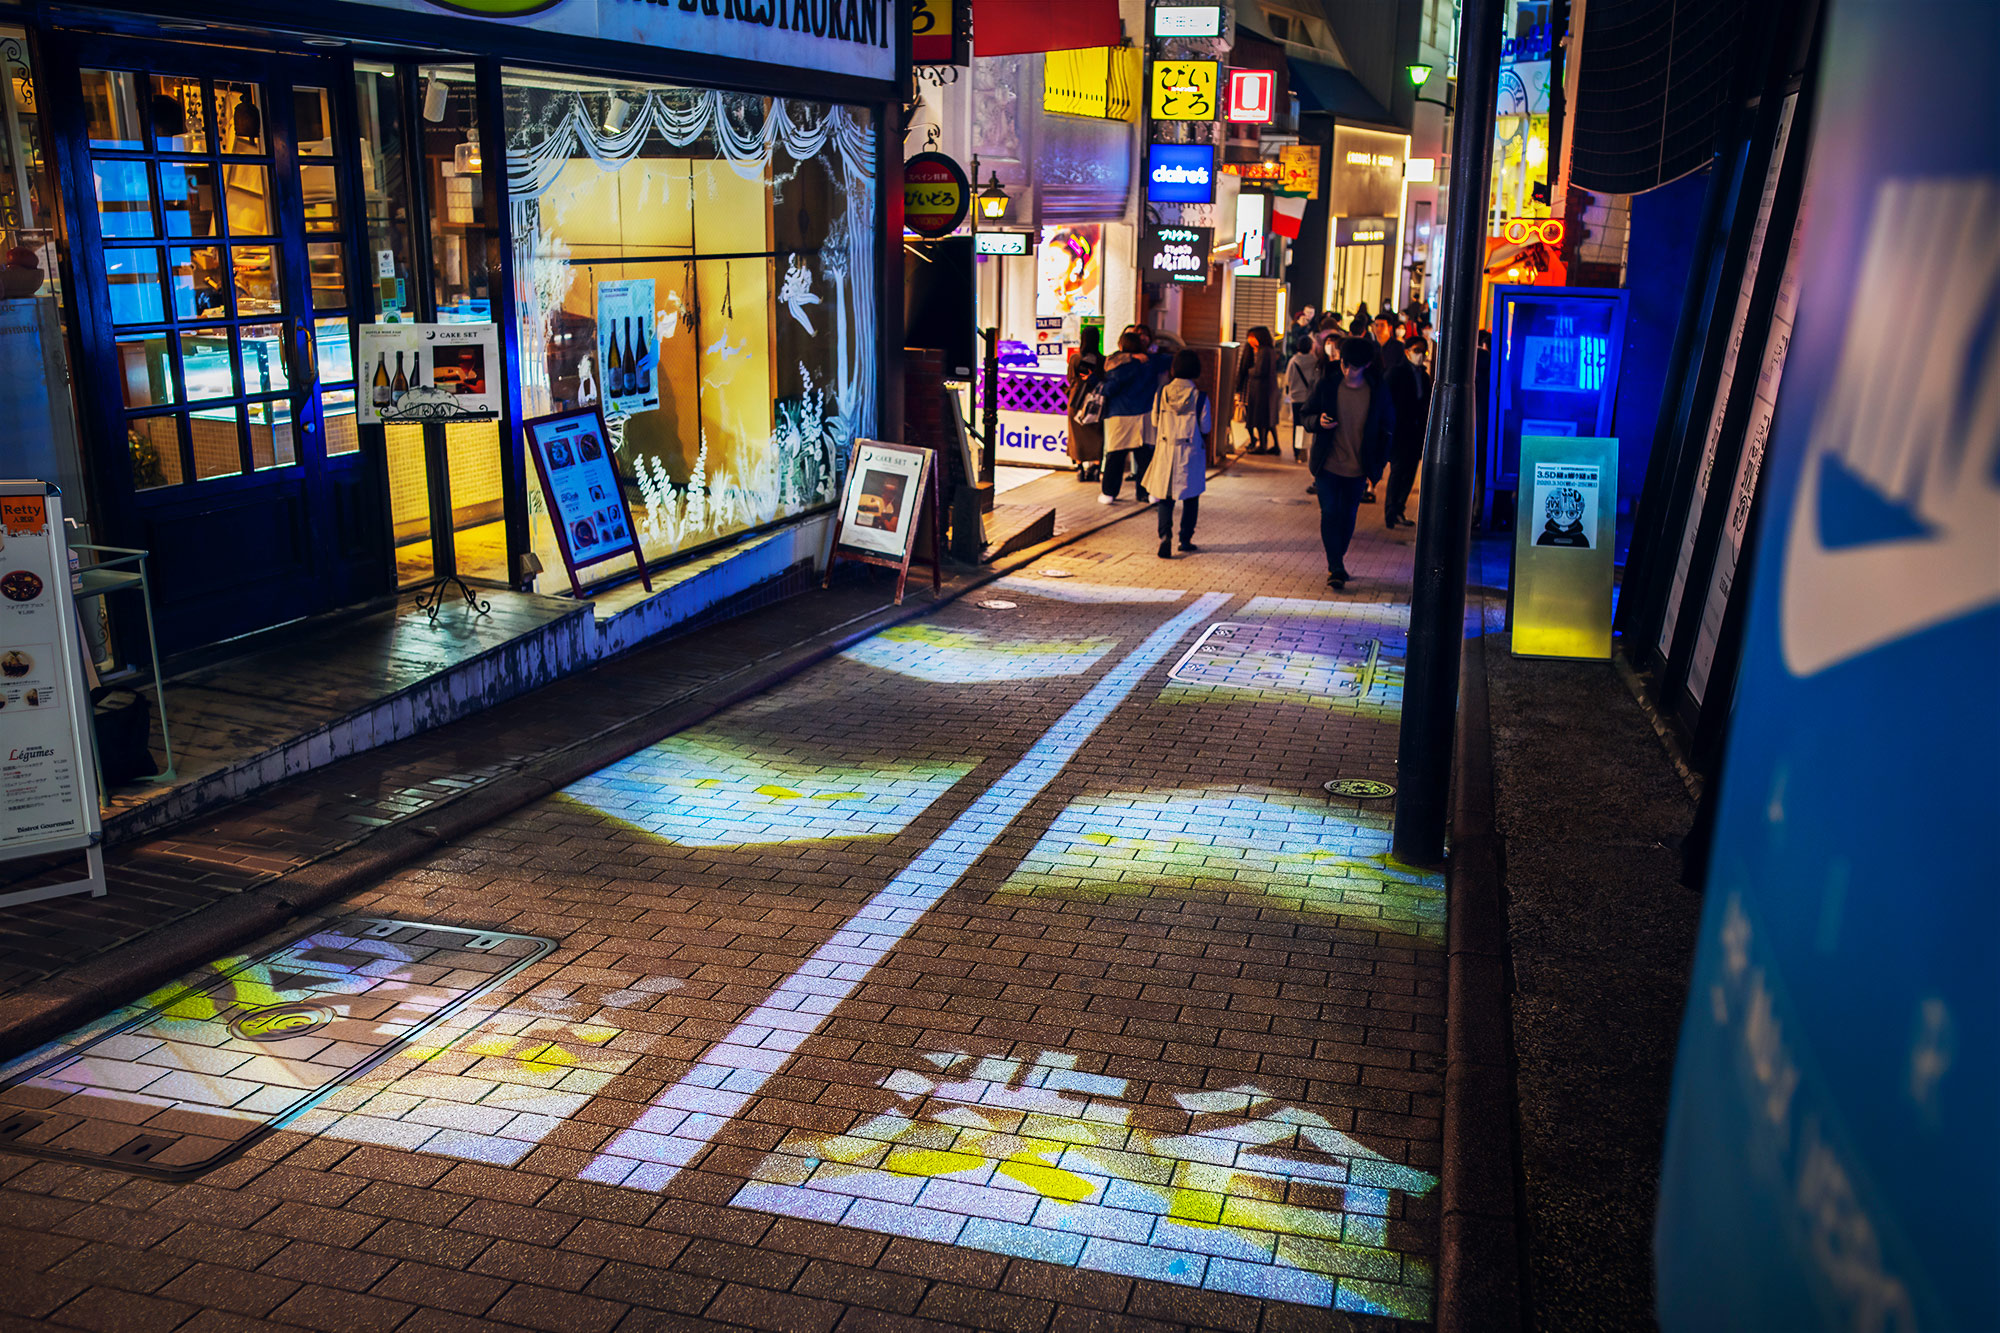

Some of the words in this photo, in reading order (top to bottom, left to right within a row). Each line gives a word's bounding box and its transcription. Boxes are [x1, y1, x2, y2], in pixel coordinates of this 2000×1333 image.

[995, 423, 1068, 453] laire's
[4, 504, 41, 516] Retty
[9, 748, 55, 762] Légumes
